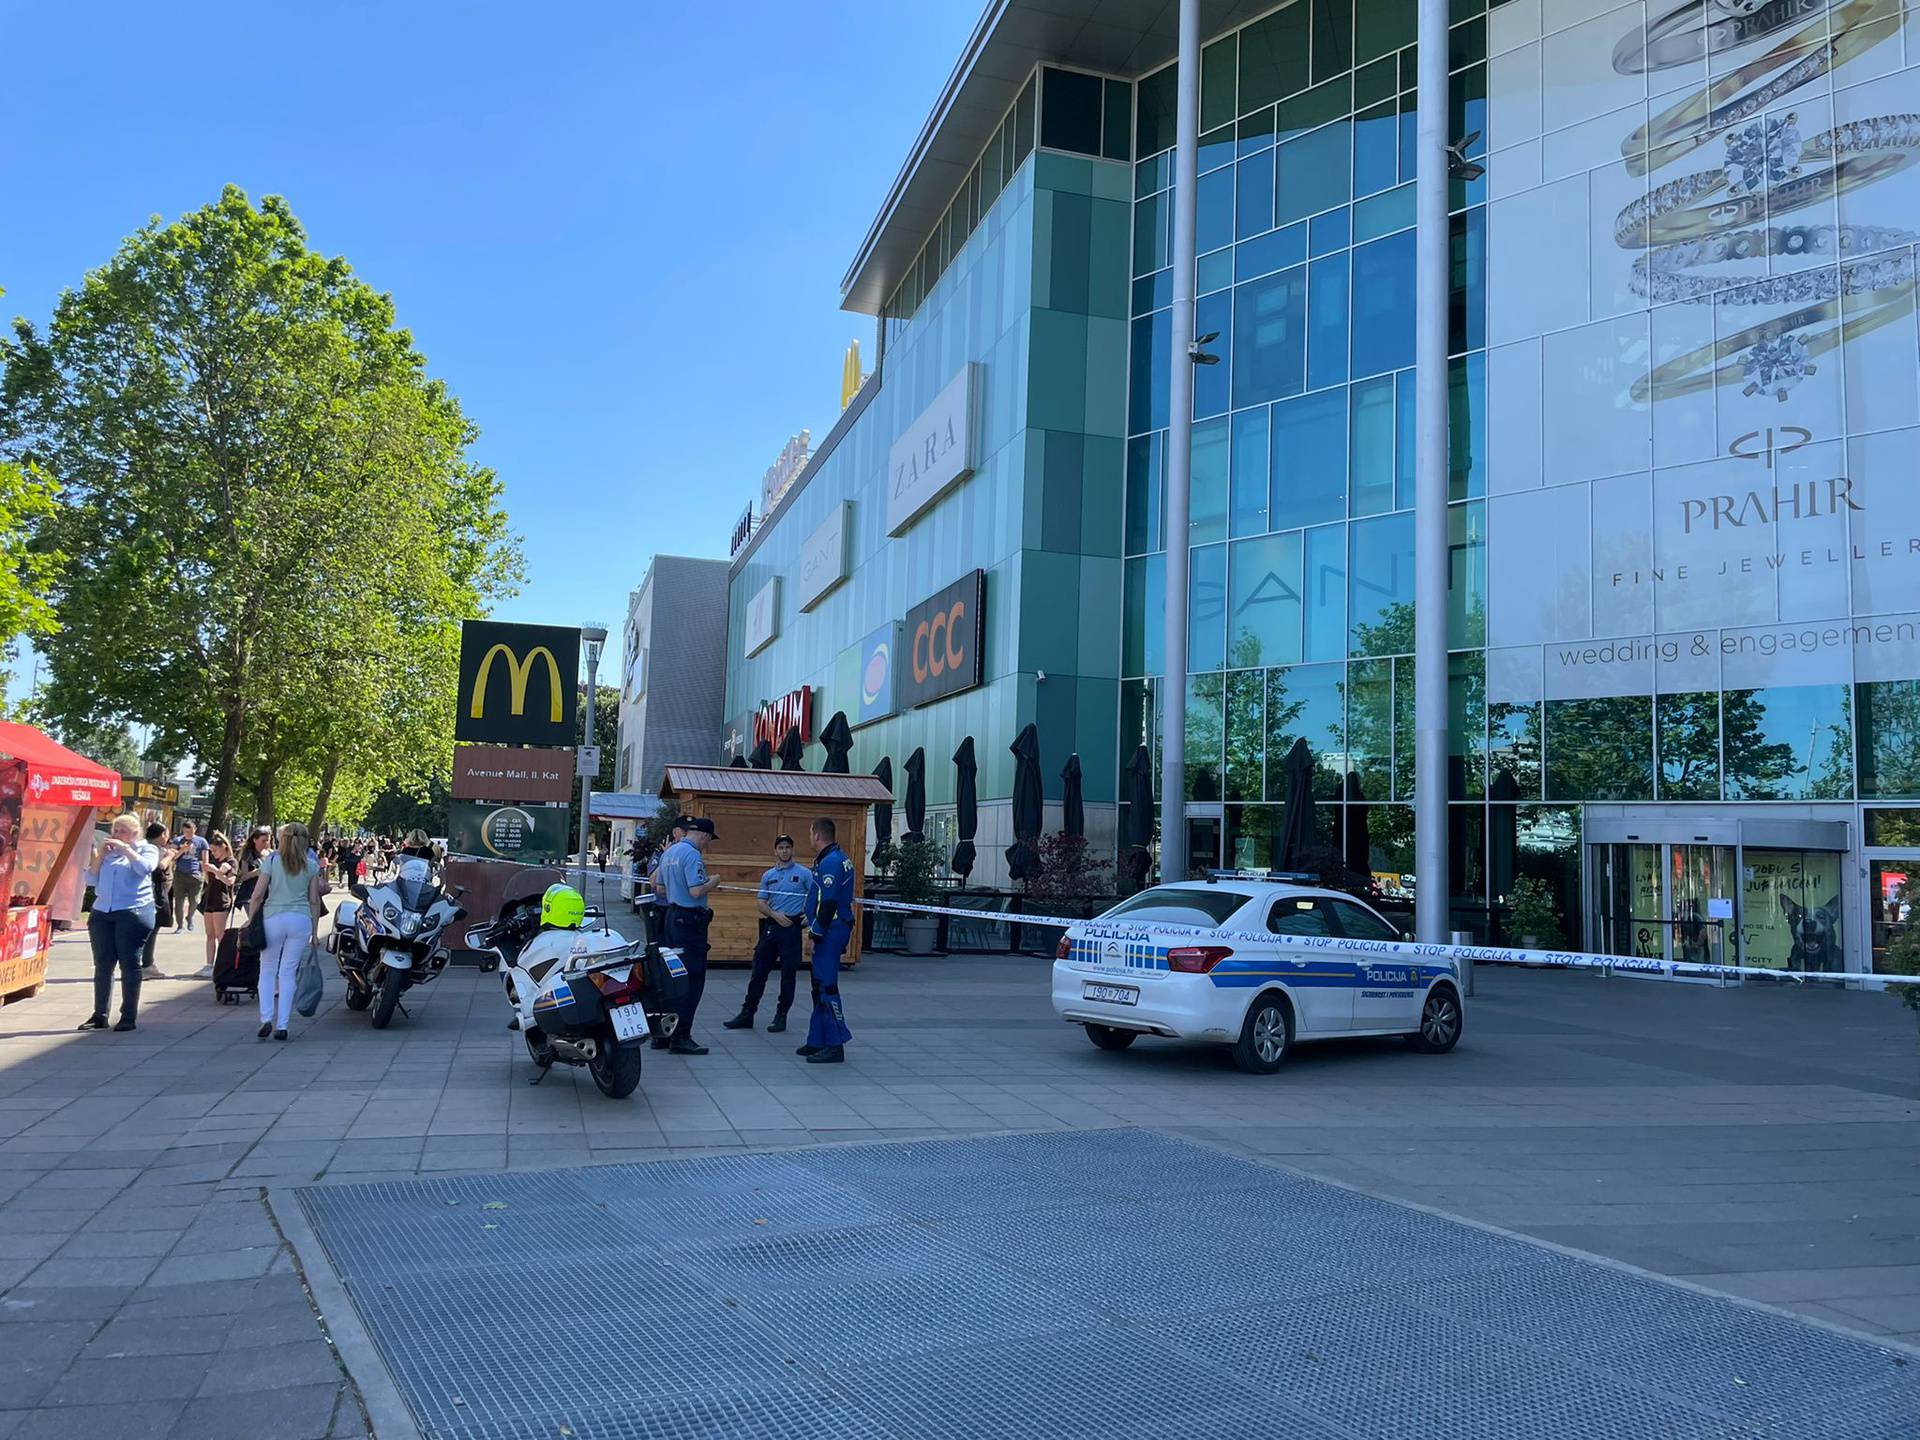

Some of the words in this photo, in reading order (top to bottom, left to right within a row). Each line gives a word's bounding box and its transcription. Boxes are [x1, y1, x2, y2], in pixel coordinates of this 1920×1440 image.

[894, 415, 957, 501] ZARA
[1680, 476, 1865, 534] PRAHIR
[1612, 565, 1689, 587] FINE
[912, 600, 965, 685] CCC
[1559, 637, 1679, 667] wedding
[1690, 633, 1711, 657] &
[1720, 620, 1920, 656] engagemen
[466, 768, 505, 778] Avenue
[542, 771, 559, 780] Kat
[1209, 930, 1234, 940] STOP
[1239, 932, 1282, 944] POLICIJA
[1304, 936, 1332, 948] STOP
[1337, 939, 1388, 953] POLICIJA
[1413, 944, 1446, 957] STOP
[1453, 947, 1513, 961] POLICIJA
[1543, 953, 1583, 967] STOP
[1366, 970, 1407, 982] POLICIJA
[1112, 989, 1130, 1001] 704
[617, 1005, 638, 1018] 190
[622, 1023, 644, 1037] 415
